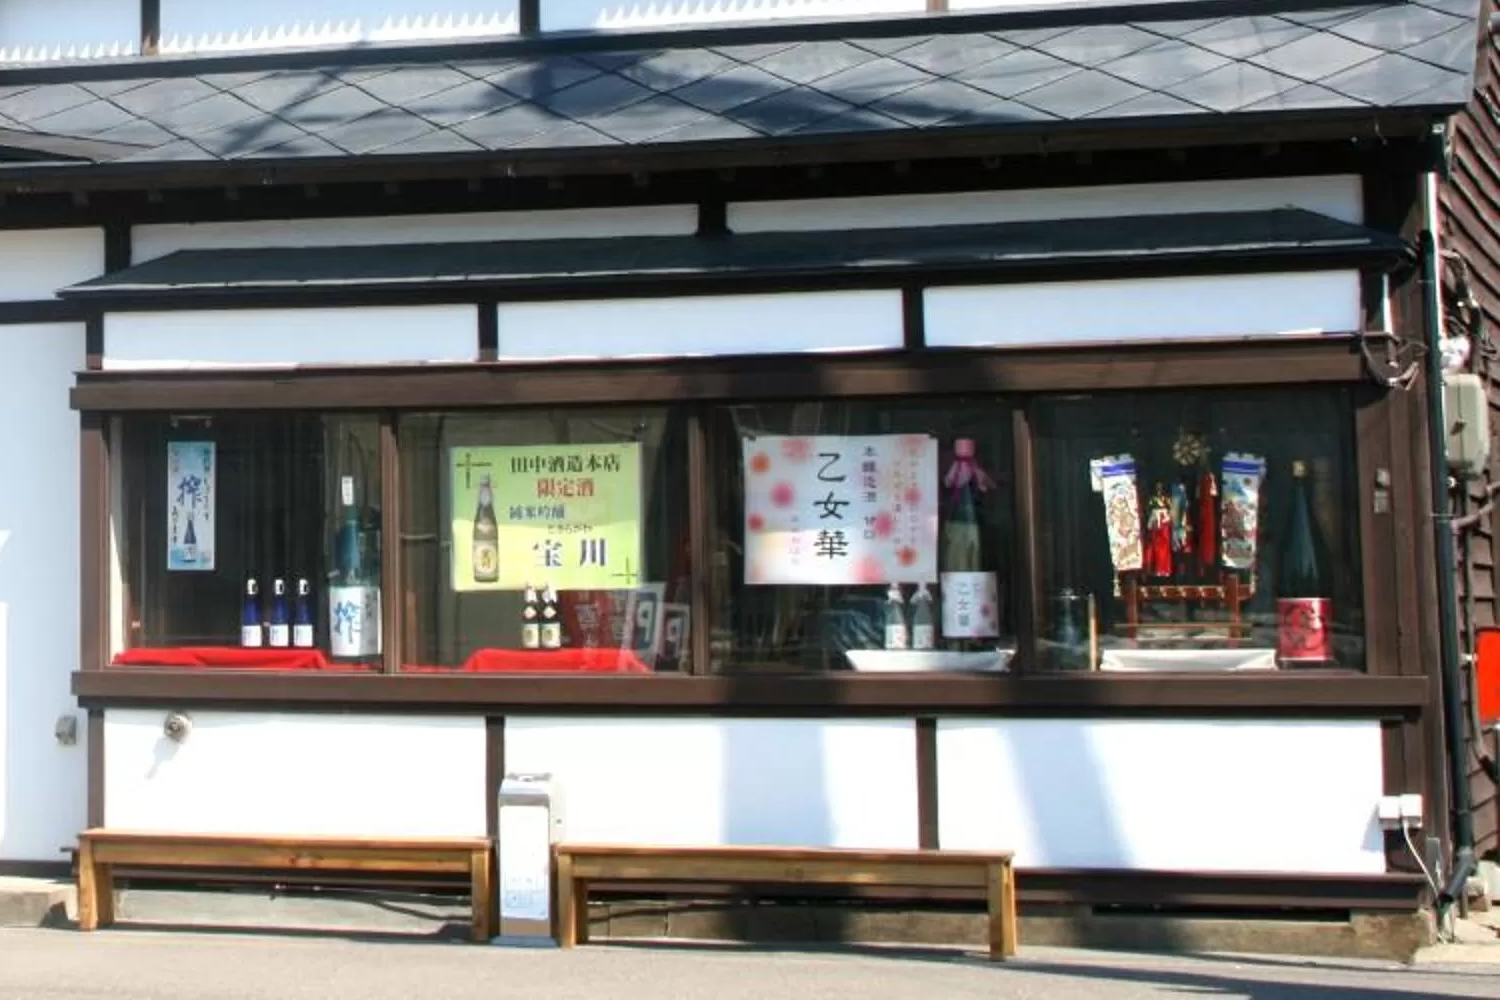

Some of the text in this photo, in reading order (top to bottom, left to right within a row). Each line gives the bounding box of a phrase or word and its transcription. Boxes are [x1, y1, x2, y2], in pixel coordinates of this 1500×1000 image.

[510, 453, 621, 474] 田中酒造本店
[537, 477, 595, 499] 限定酒
[509, 504, 565, 521] 純米吟醸
[813, 452, 851, 559] 乙女華
[532, 538, 607, 568] 宝川
